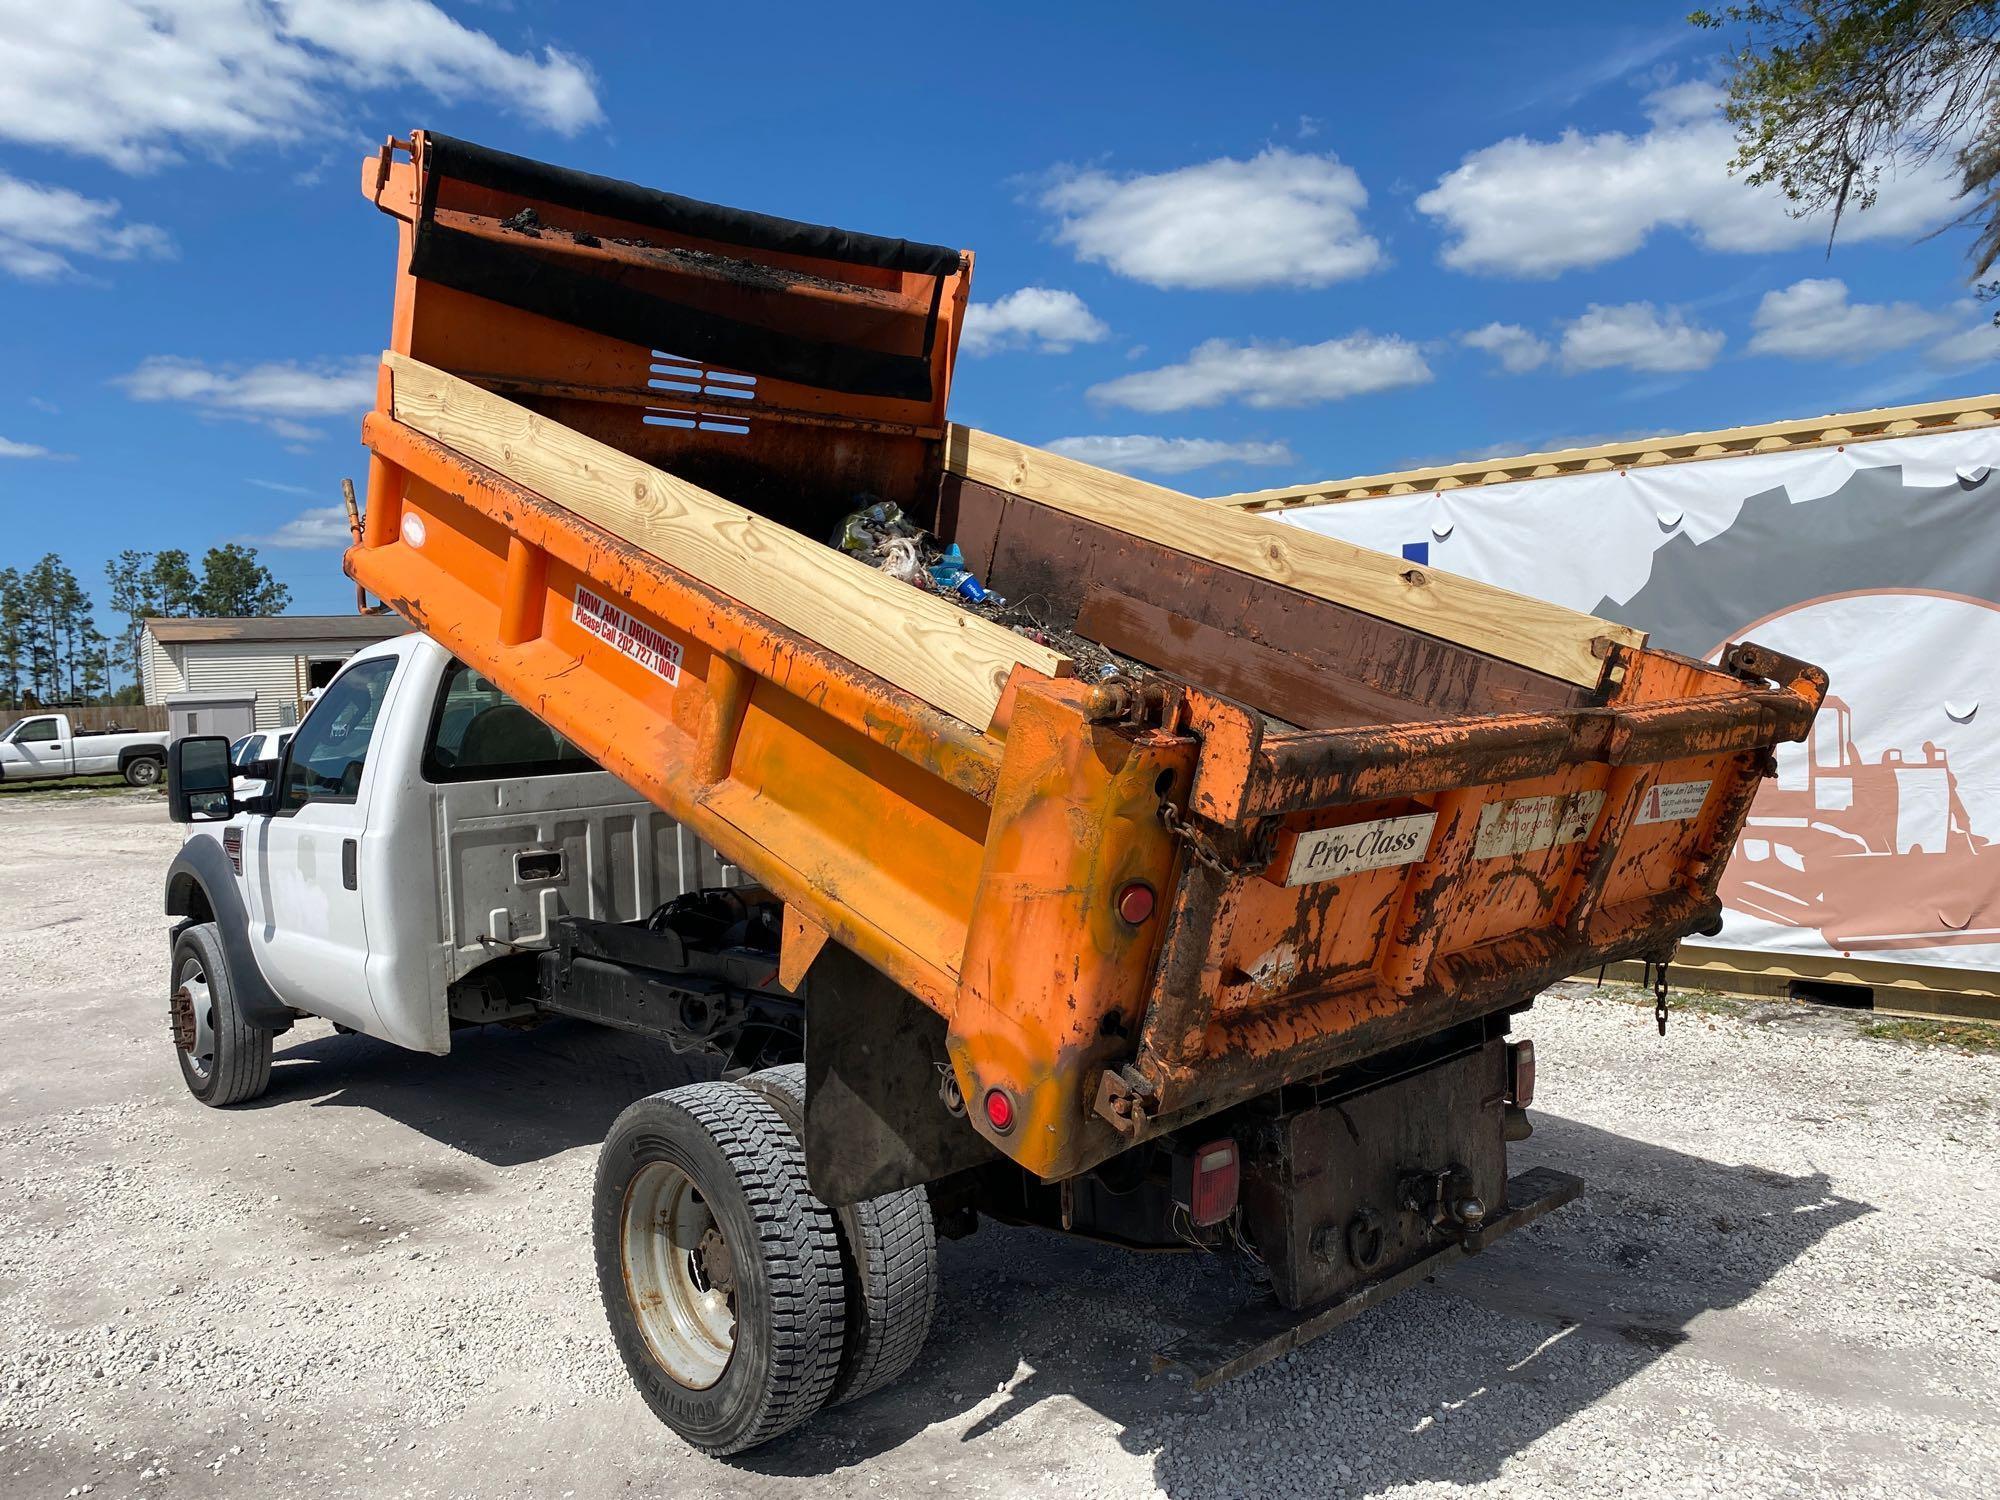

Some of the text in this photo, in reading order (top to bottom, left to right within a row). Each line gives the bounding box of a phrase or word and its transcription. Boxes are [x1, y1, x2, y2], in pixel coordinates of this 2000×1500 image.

[576, 607, 677, 681] Please Call 202.727.1000
[577, 589, 680, 662] HOW AM I DRIVING?
[1512, 801, 1533, 815] How
[1533, 801, 1547, 814] Am
[1521, 821, 1530, 832] or
[1306, 829, 1419, 868] Pro-Class
